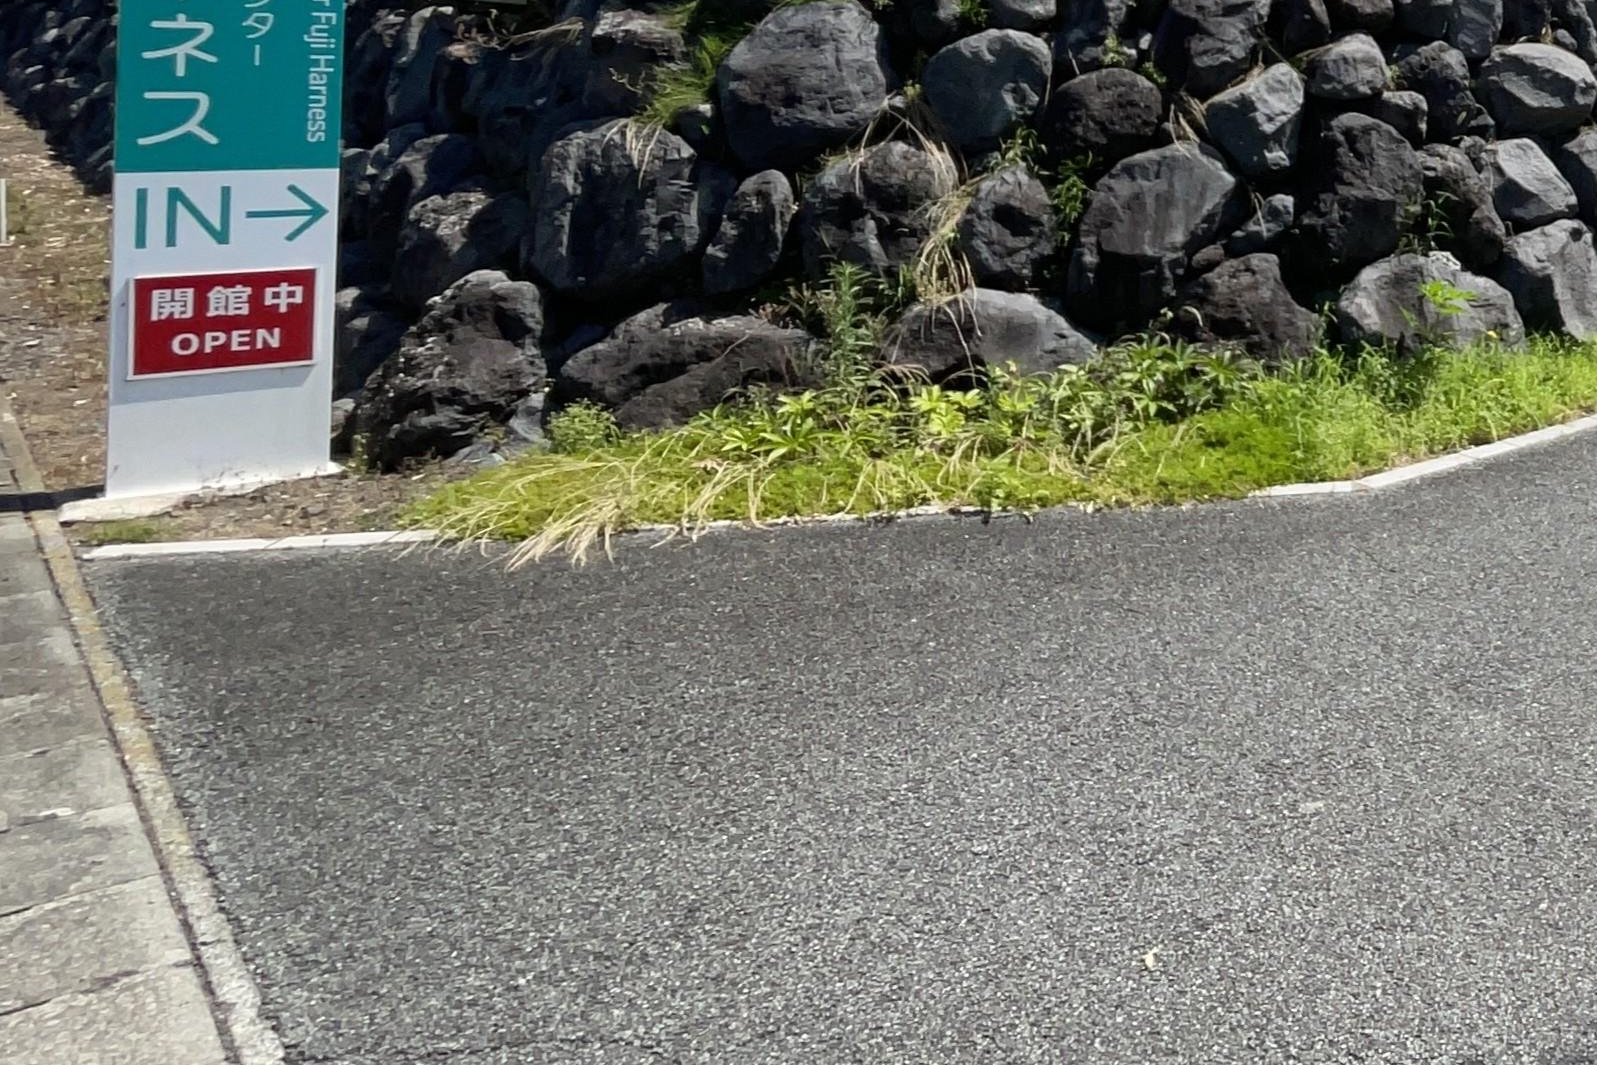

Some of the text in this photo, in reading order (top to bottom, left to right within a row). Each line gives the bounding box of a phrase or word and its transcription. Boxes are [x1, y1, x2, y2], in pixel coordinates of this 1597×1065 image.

[303, 12, 337, 49] Fuji
[306, 55, 336, 142] Harness
[135, 186, 231, 249] IN
[150, 282, 303, 321] 開館中
[171, 327, 280, 355] OPEN
